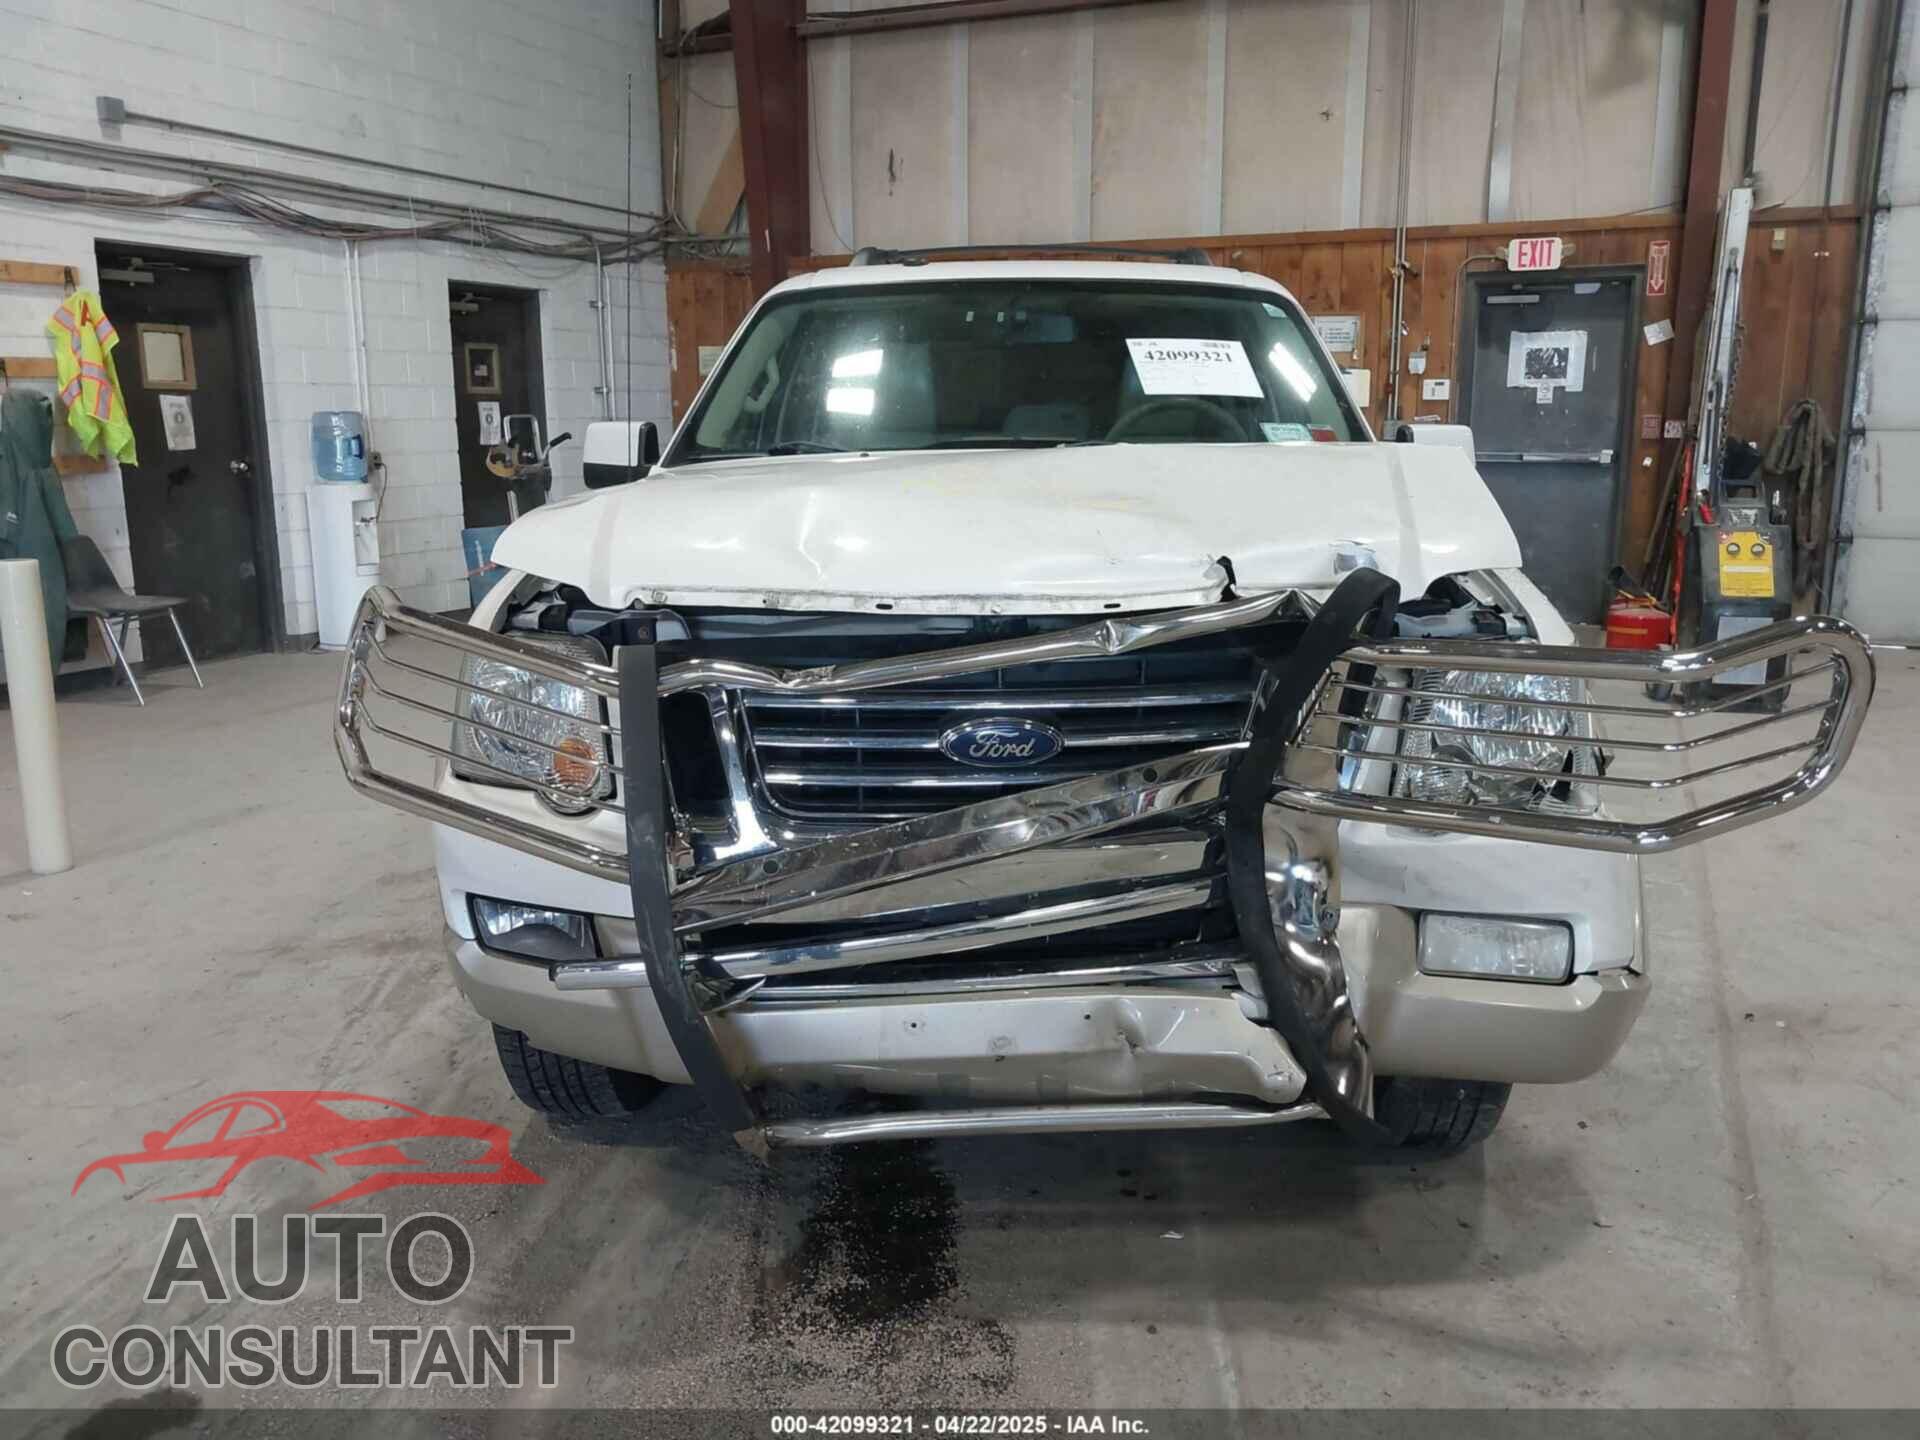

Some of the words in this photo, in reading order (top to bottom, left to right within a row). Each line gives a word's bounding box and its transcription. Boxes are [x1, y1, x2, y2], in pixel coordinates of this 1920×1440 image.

[1517, 240, 1555, 268] EXIT
[1144, 350, 1232, 362] 42099321
[969, 730, 1036, 757] Ford
